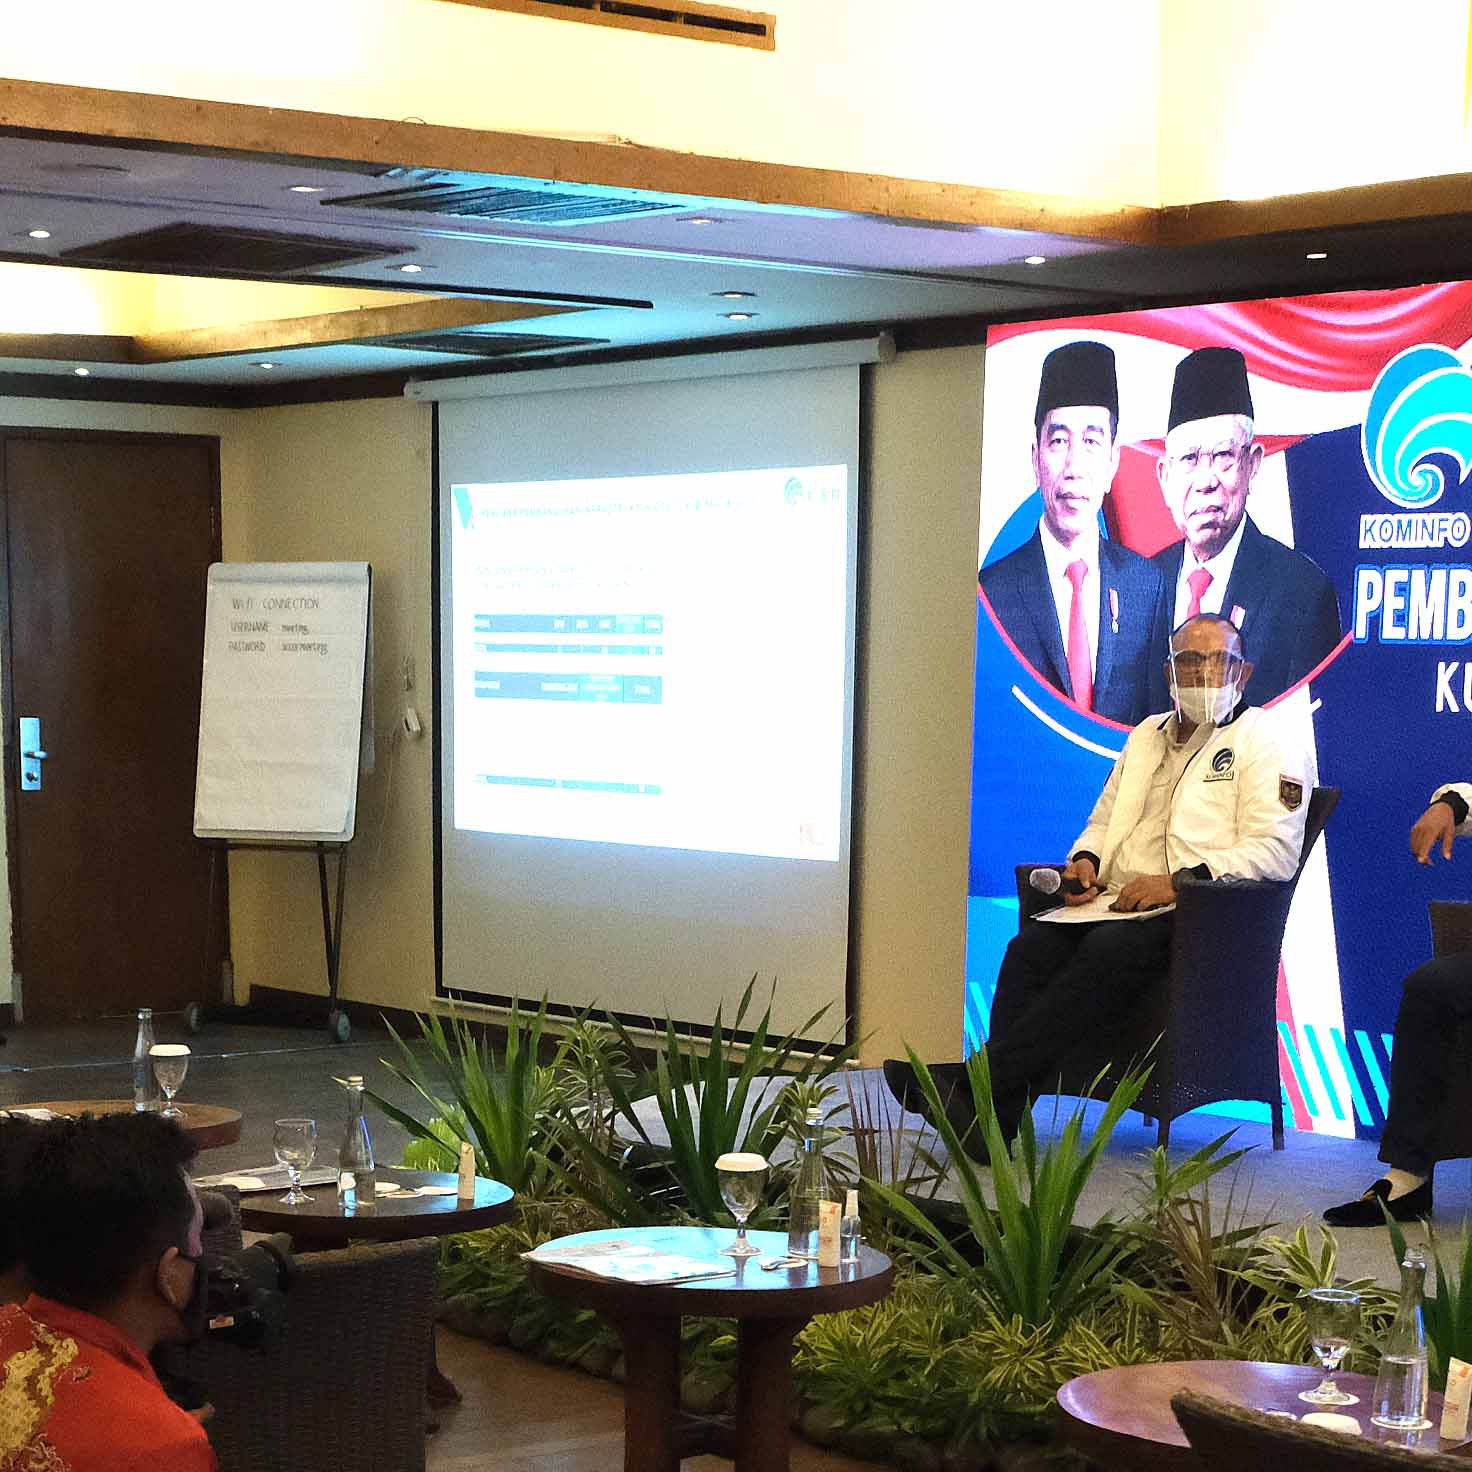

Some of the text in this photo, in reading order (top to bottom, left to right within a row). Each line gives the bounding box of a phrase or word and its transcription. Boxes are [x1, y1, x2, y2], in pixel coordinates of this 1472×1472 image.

[1359, 513, 1471, 549] KOMINFO
[262, 598, 320, 609] CONNECTION
[230, 621, 270, 632] USERNAME
[228, 640, 266, 652] PASSWORD
